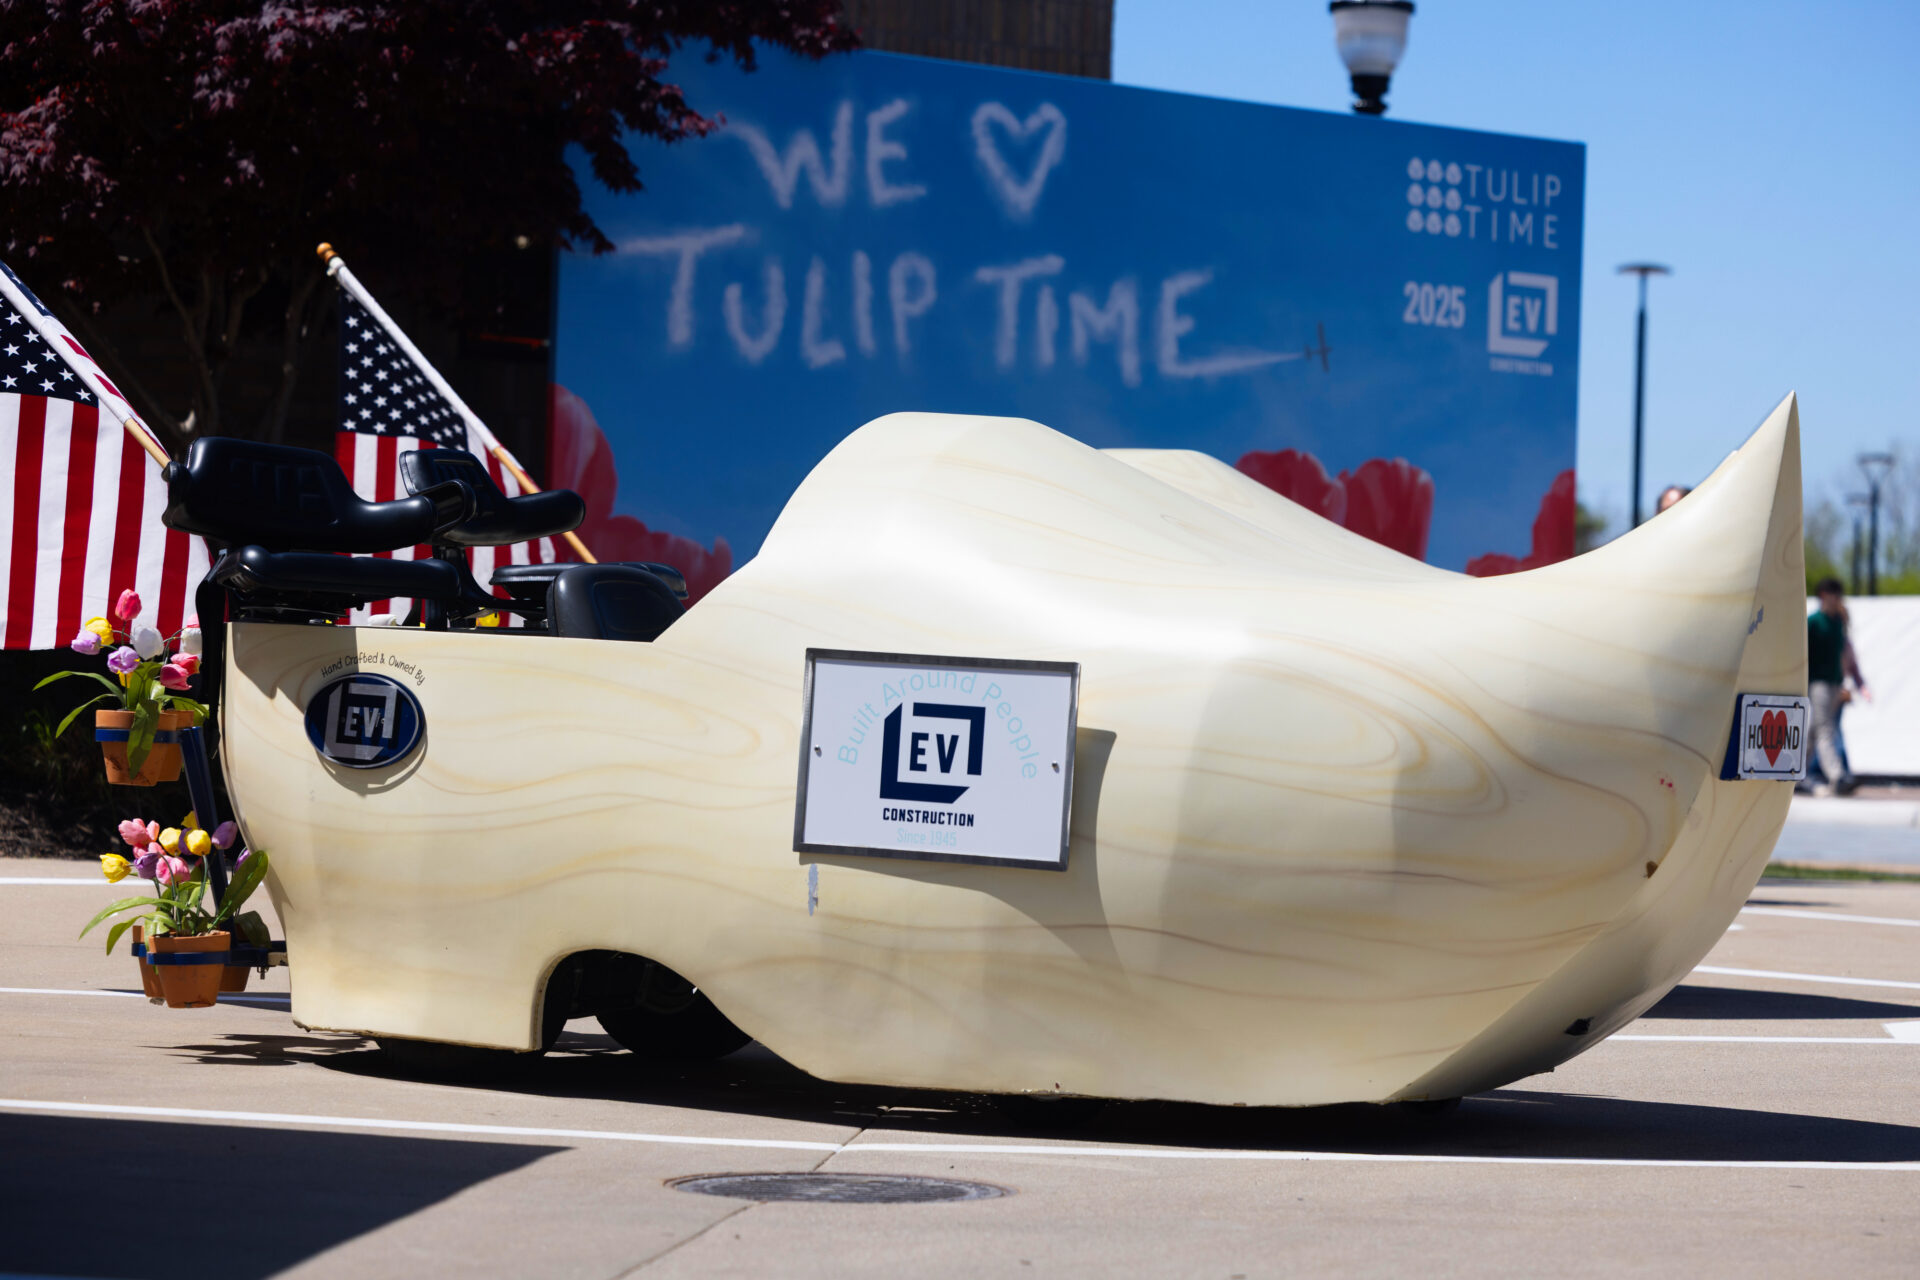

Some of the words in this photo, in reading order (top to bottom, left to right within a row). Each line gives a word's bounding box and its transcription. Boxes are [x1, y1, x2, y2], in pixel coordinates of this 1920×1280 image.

[724, 99, 926, 208] WE
[1465, 164, 1561, 207] TULIP
[1463, 204, 1559, 249] TIME
[614, 223, 938, 369] TULIP
[975, 254, 1294, 388] TIME
[1402, 281, 1467, 328] 2025
[1506, 294, 1542, 333] EV
[321, 659, 342, 678] Hand
[344, 652, 378, 666] Crafted
[379, 653, 386, 664] &
[388, 655, 416, 674] Owned
[415, 669, 425, 686] By
[344, 706, 379, 737] EV
[837, 702, 882, 765] Built
[881, 670, 978, 707] Around
[981, 682, 1040, 780] People
[1748, 725, 1800, 749] HOLLAND
[909, 731, 960, 774] EV
[883, 808, 974, 827] CONSTRUCTION
[896, 827, 927, 845] Since
[929, 830, 958, 847] 1945
